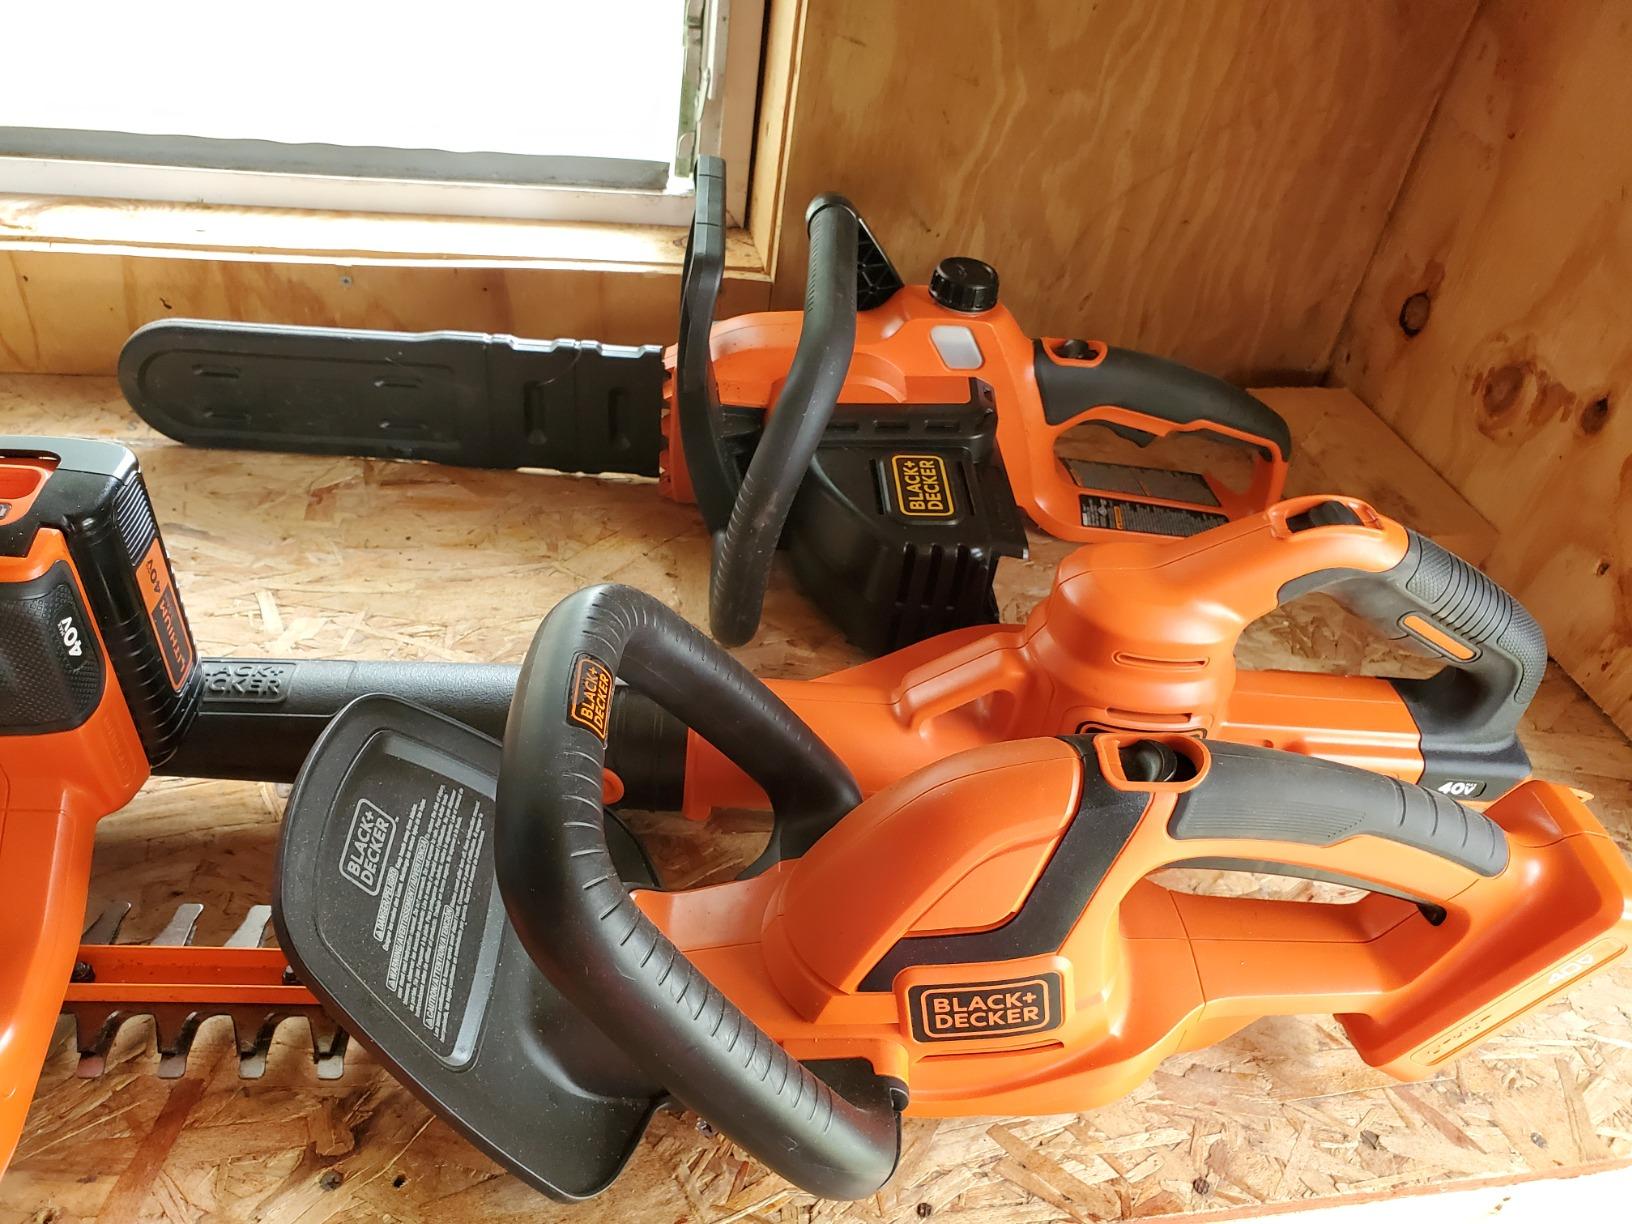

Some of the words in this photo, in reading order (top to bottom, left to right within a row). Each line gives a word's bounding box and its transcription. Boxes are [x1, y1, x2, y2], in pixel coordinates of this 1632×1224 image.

[903, 460, 926, 510] BLACK+
[919, 460, 944, 510] DECKER
[60, 616, 83, 656] 40V
[160, 600, 186, 673] LITHIUM
[580, 666, 599, 720] BLACK+
[594, 673, 609, 730] DECKER
[1438, 781, 1478, 795] 40V
[347, 810, 375, 877] BLACK+
[359, 816, 390, 887] DECKER
[933, 991, 1037, 1013] BLACK+
[934, 1006, 1040, 1029] DECKER
